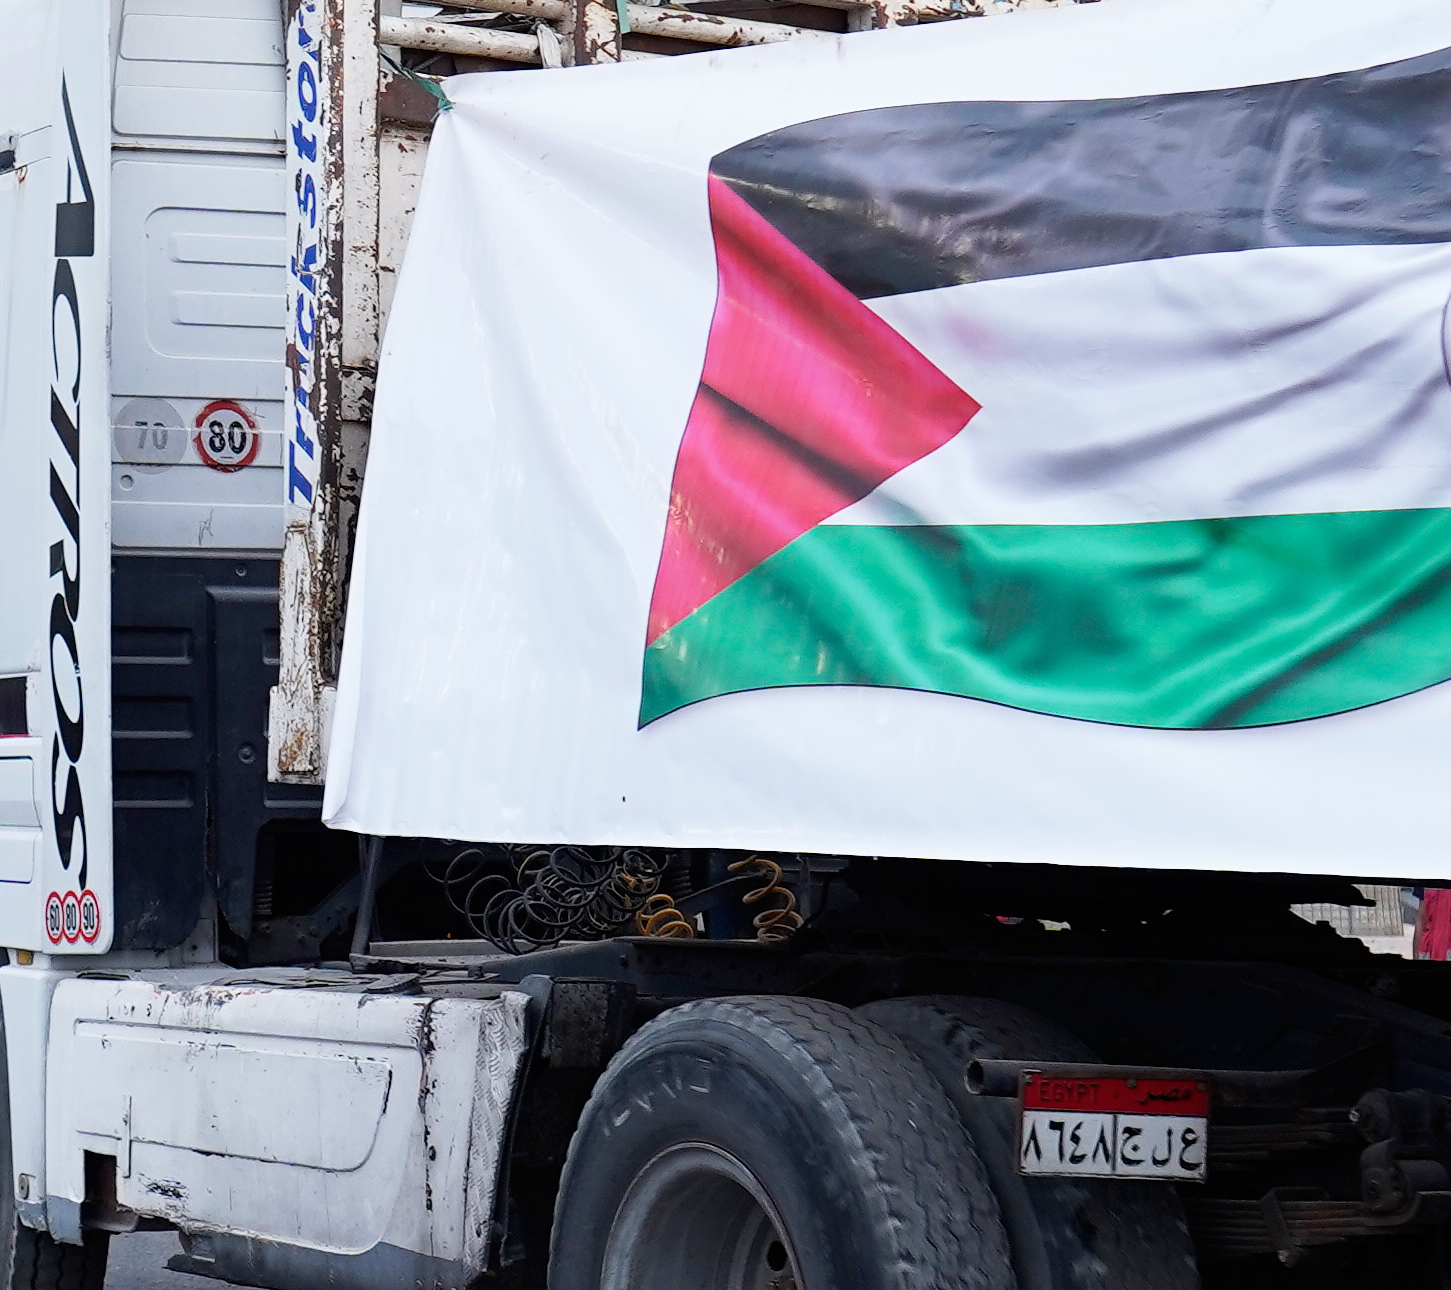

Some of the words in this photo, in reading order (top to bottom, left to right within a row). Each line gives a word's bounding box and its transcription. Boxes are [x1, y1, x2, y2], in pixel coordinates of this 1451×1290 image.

[134, 420, 169, 450] 70
[208, 419, 247, 454] 80
[49, 904, 60, 932] 60
[65, 903, 77, 931] 80
[83, 902, 95, 930] 90
[1039, 1081, 1100, 1103] EGYPT
[1136, 1087, 1193, 1105] مصر
